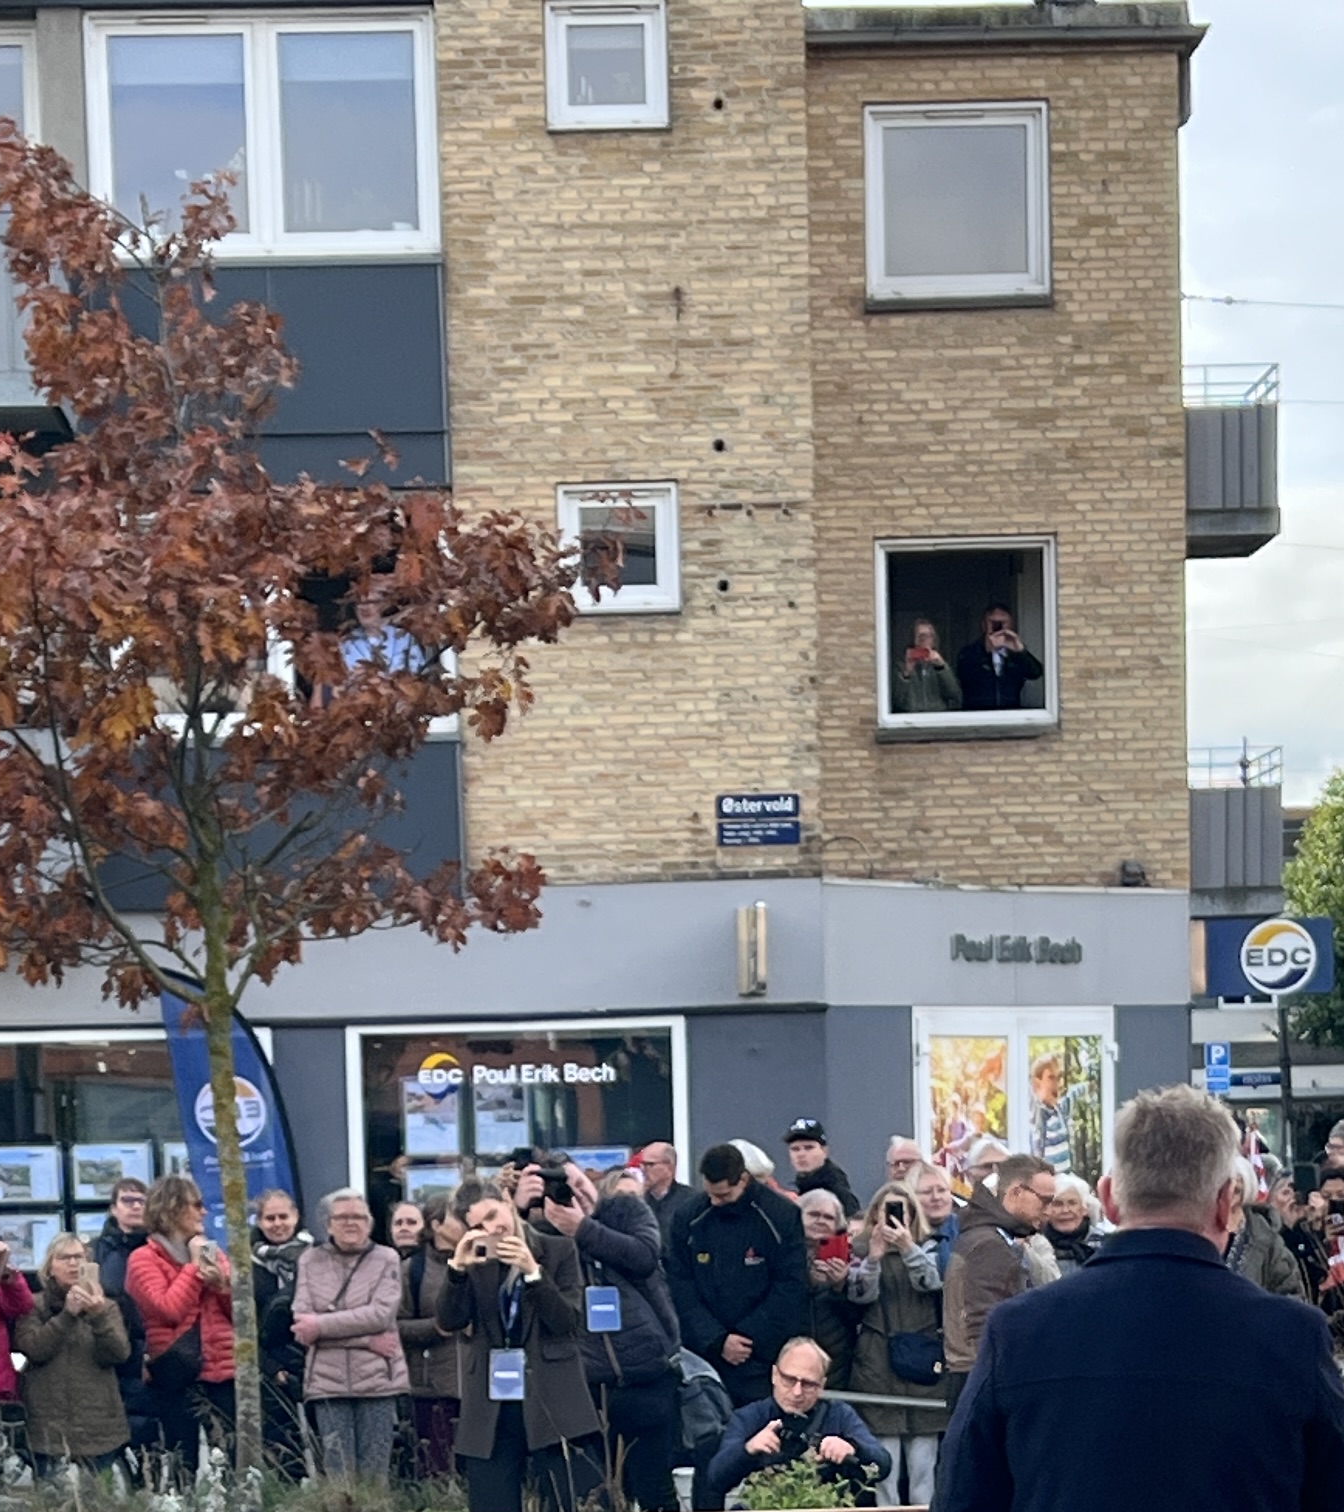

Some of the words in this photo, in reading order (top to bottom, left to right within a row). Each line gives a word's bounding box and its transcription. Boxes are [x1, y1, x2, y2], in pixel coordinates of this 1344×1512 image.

[950, 933, 994, 962] Poul
[995, 934, 1033, 963] Erik
[1033, 935, 1083, 964] Bech
[1246, 947, 1311, 967] EDC
[1211, 1045, 1225, 1064] P
[418, 1068, 463, 1084] EDC
[473, 1065, 516, 1084] Poul
[520, 1064, 559, 1083] Erik
[563, 1062, 617, 1083] Bech
